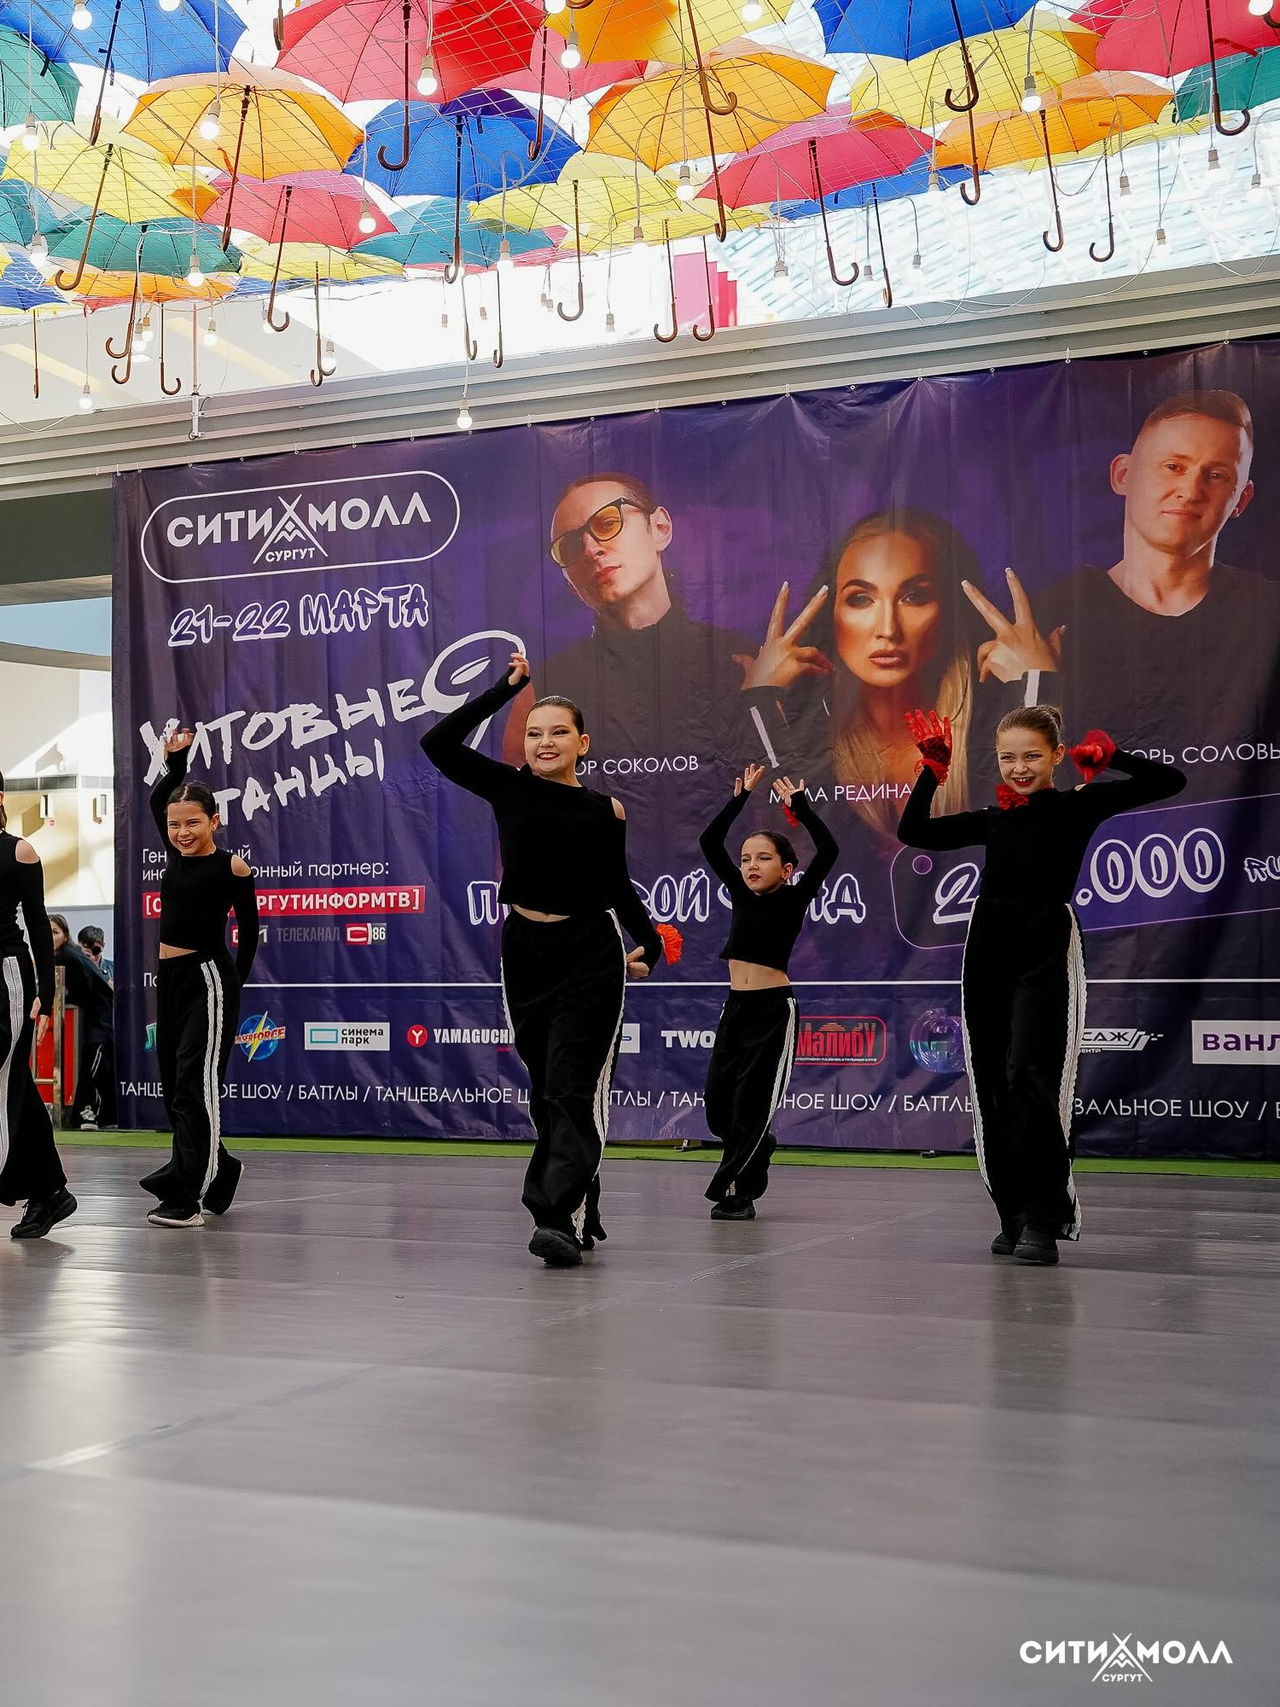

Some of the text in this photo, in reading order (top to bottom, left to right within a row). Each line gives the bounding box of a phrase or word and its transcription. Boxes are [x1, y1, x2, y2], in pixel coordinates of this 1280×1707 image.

[265, 547, 317, 563] СУРГУТ
[168, 583, 430, 647] 21-22 МАРТА
[602, 755, 699, 775] СОКОЛОВ
[834, 783, 912, 802] РЕДИНА
[308, 860, 390, 880] партнер:
[277, 927, 341, 942] ТЕЛЕКАНАЛ
[341, 1027, 384, 1037] синема
[341, 1036, 370, 1046] парк
[242, 1084, 282, 1099] ШОУ
[298, 1084, 358, 1101] БАТТЛЫ
[375, 1086, 512, 1105] ТАНЦЕВАЛЬНОЕ
[830, 1094, 882, 1111] ШОУ
[1190, 1100, 1250, 1118] ШОУ
